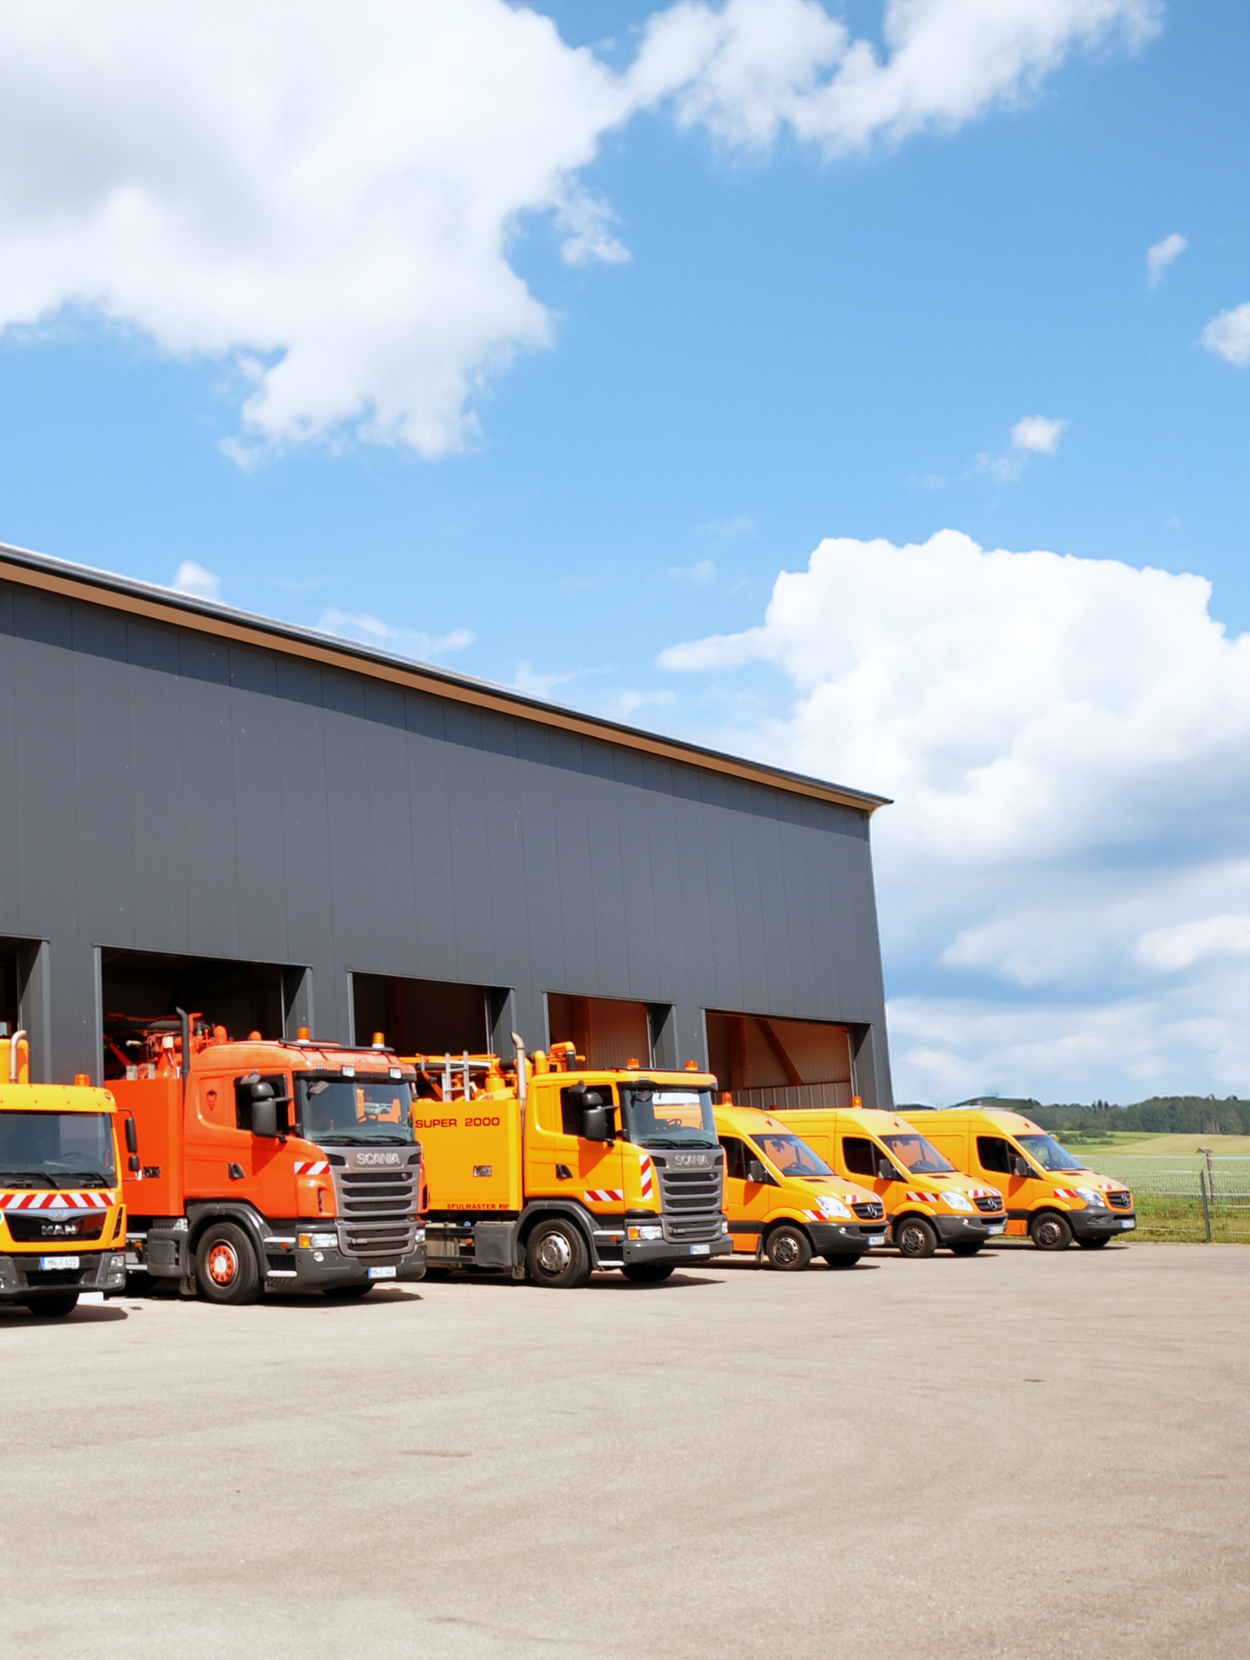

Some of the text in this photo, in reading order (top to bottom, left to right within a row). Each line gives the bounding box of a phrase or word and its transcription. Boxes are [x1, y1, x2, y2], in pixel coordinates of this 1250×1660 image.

[415, 1117, 500, 1128] SUPER 2000
[356, 1152, 401, 1165] SCANIA
[674, 1155, 709, 1166] SCANIA
